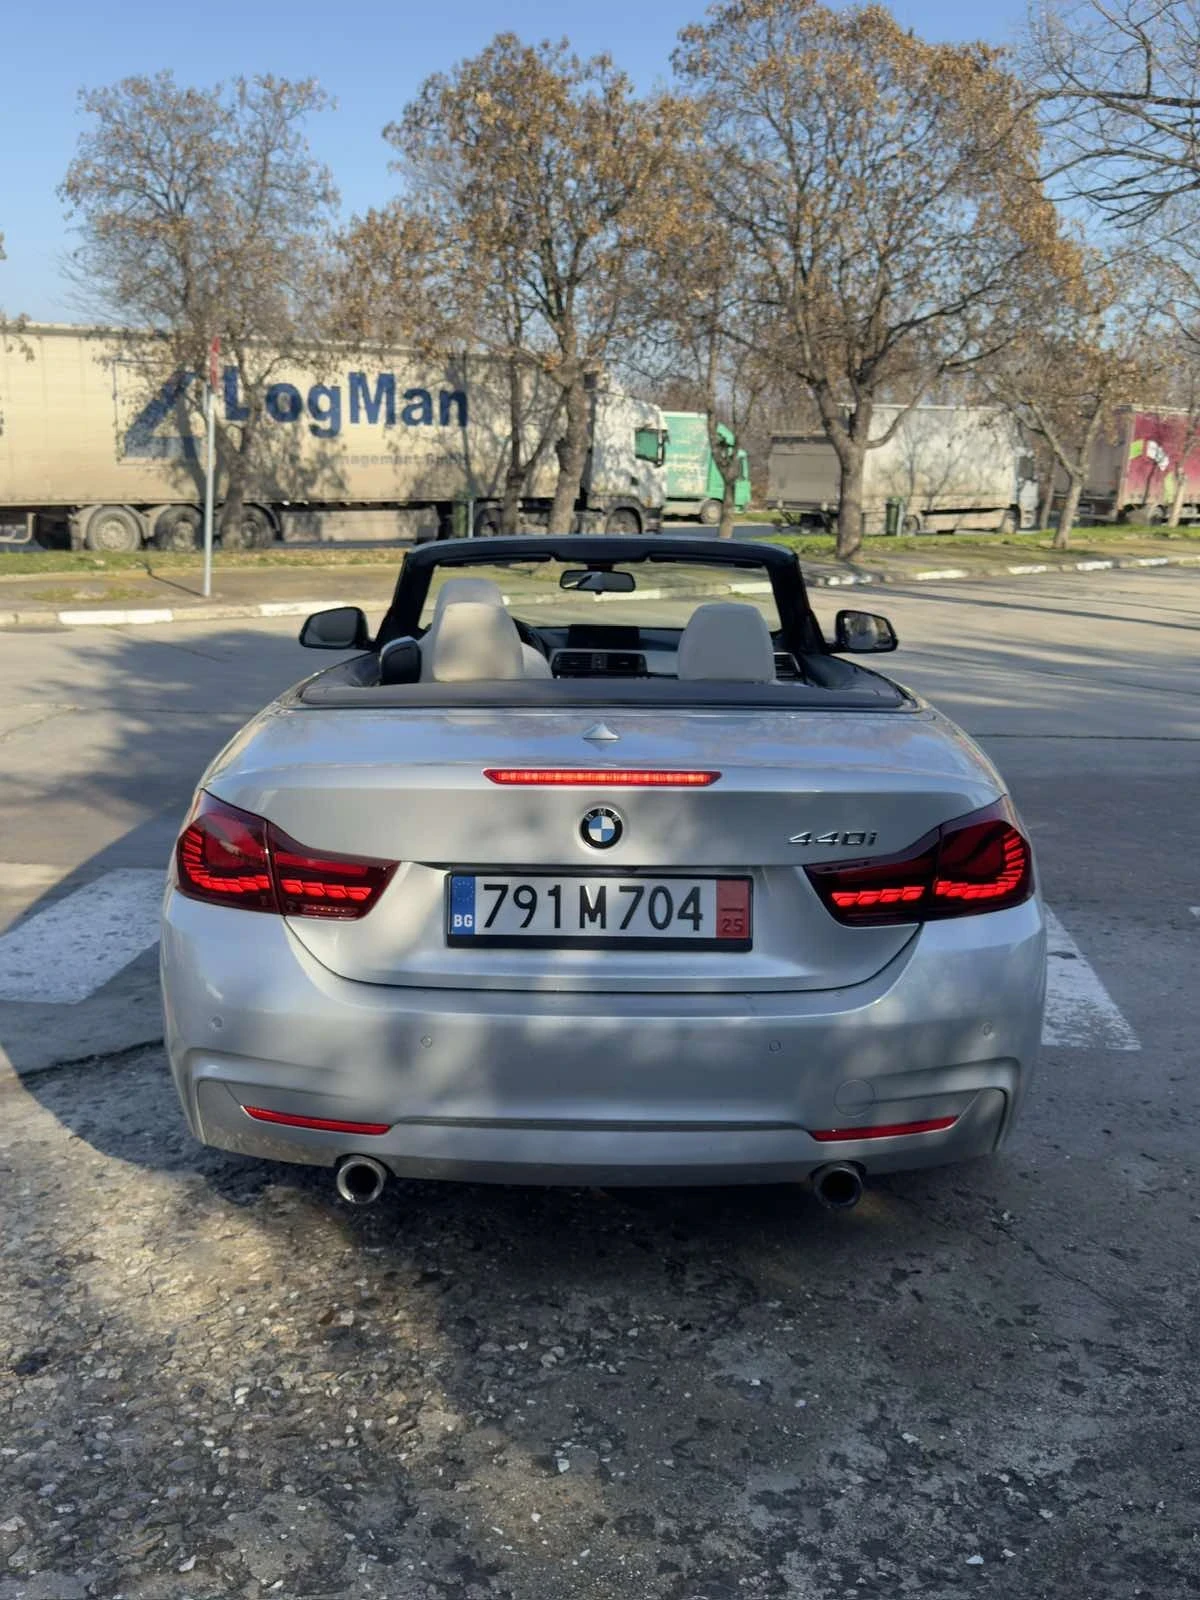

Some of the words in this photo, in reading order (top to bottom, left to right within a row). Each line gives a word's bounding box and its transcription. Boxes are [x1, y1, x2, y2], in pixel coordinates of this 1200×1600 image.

[223, 364, 468, 438] LogMan
[584, 808, 621, 823] BMW
[788, 831, 877, 846] 440i
[453, 914, 473, 928] BG
[722, 918, 745, 933] 25
